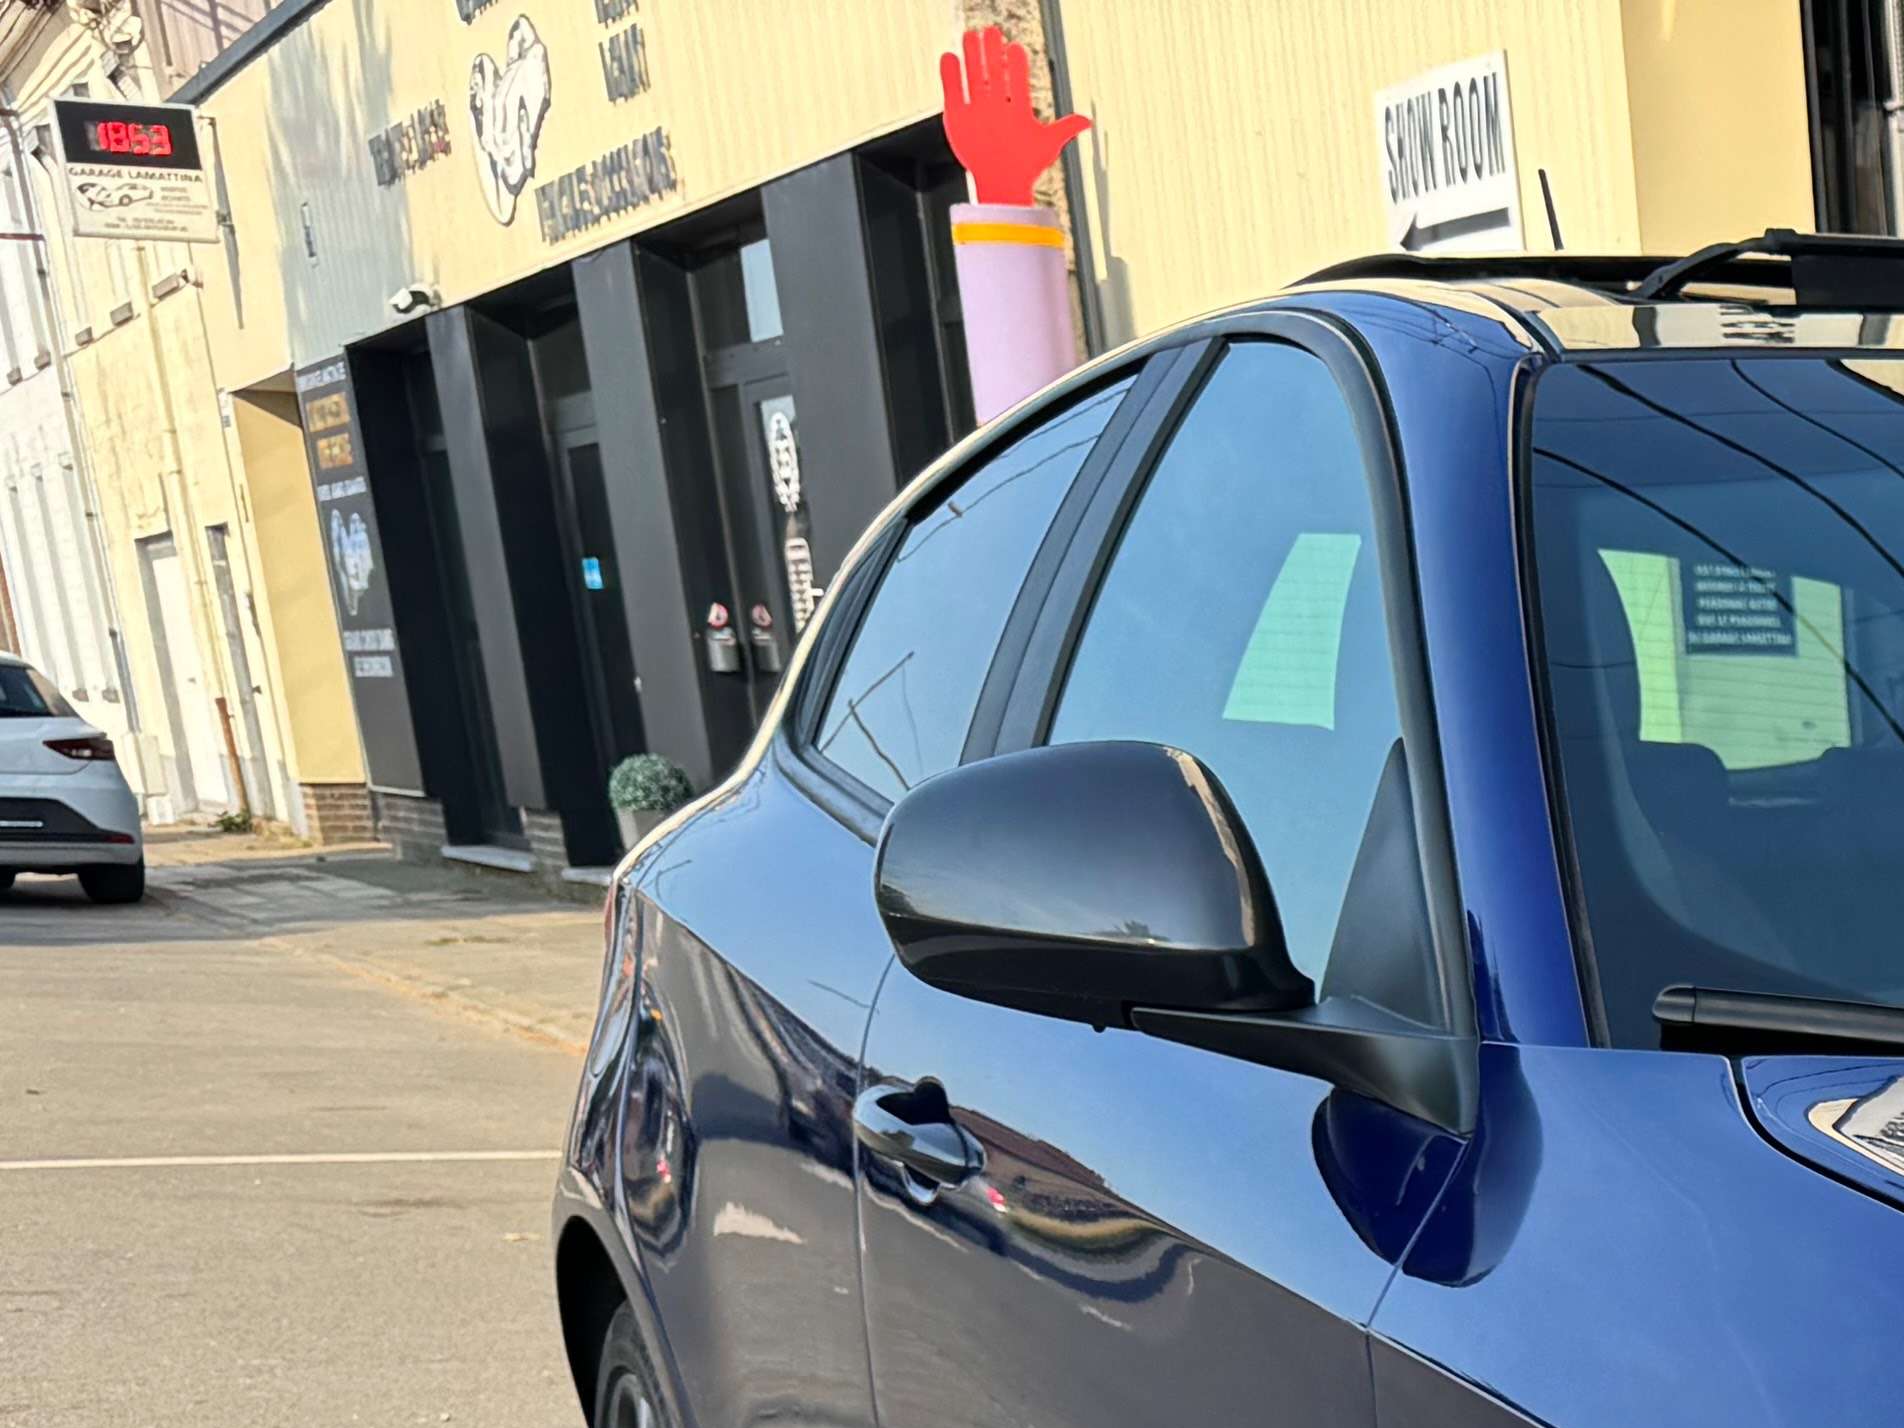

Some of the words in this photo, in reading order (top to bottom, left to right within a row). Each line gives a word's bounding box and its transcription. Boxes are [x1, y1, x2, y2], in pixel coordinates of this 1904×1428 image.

[69, 167, 123, 179] GARAGE
[1384, 88, 1437, 205] SHOW
[1437, 72, 1507, 187] ROOM
